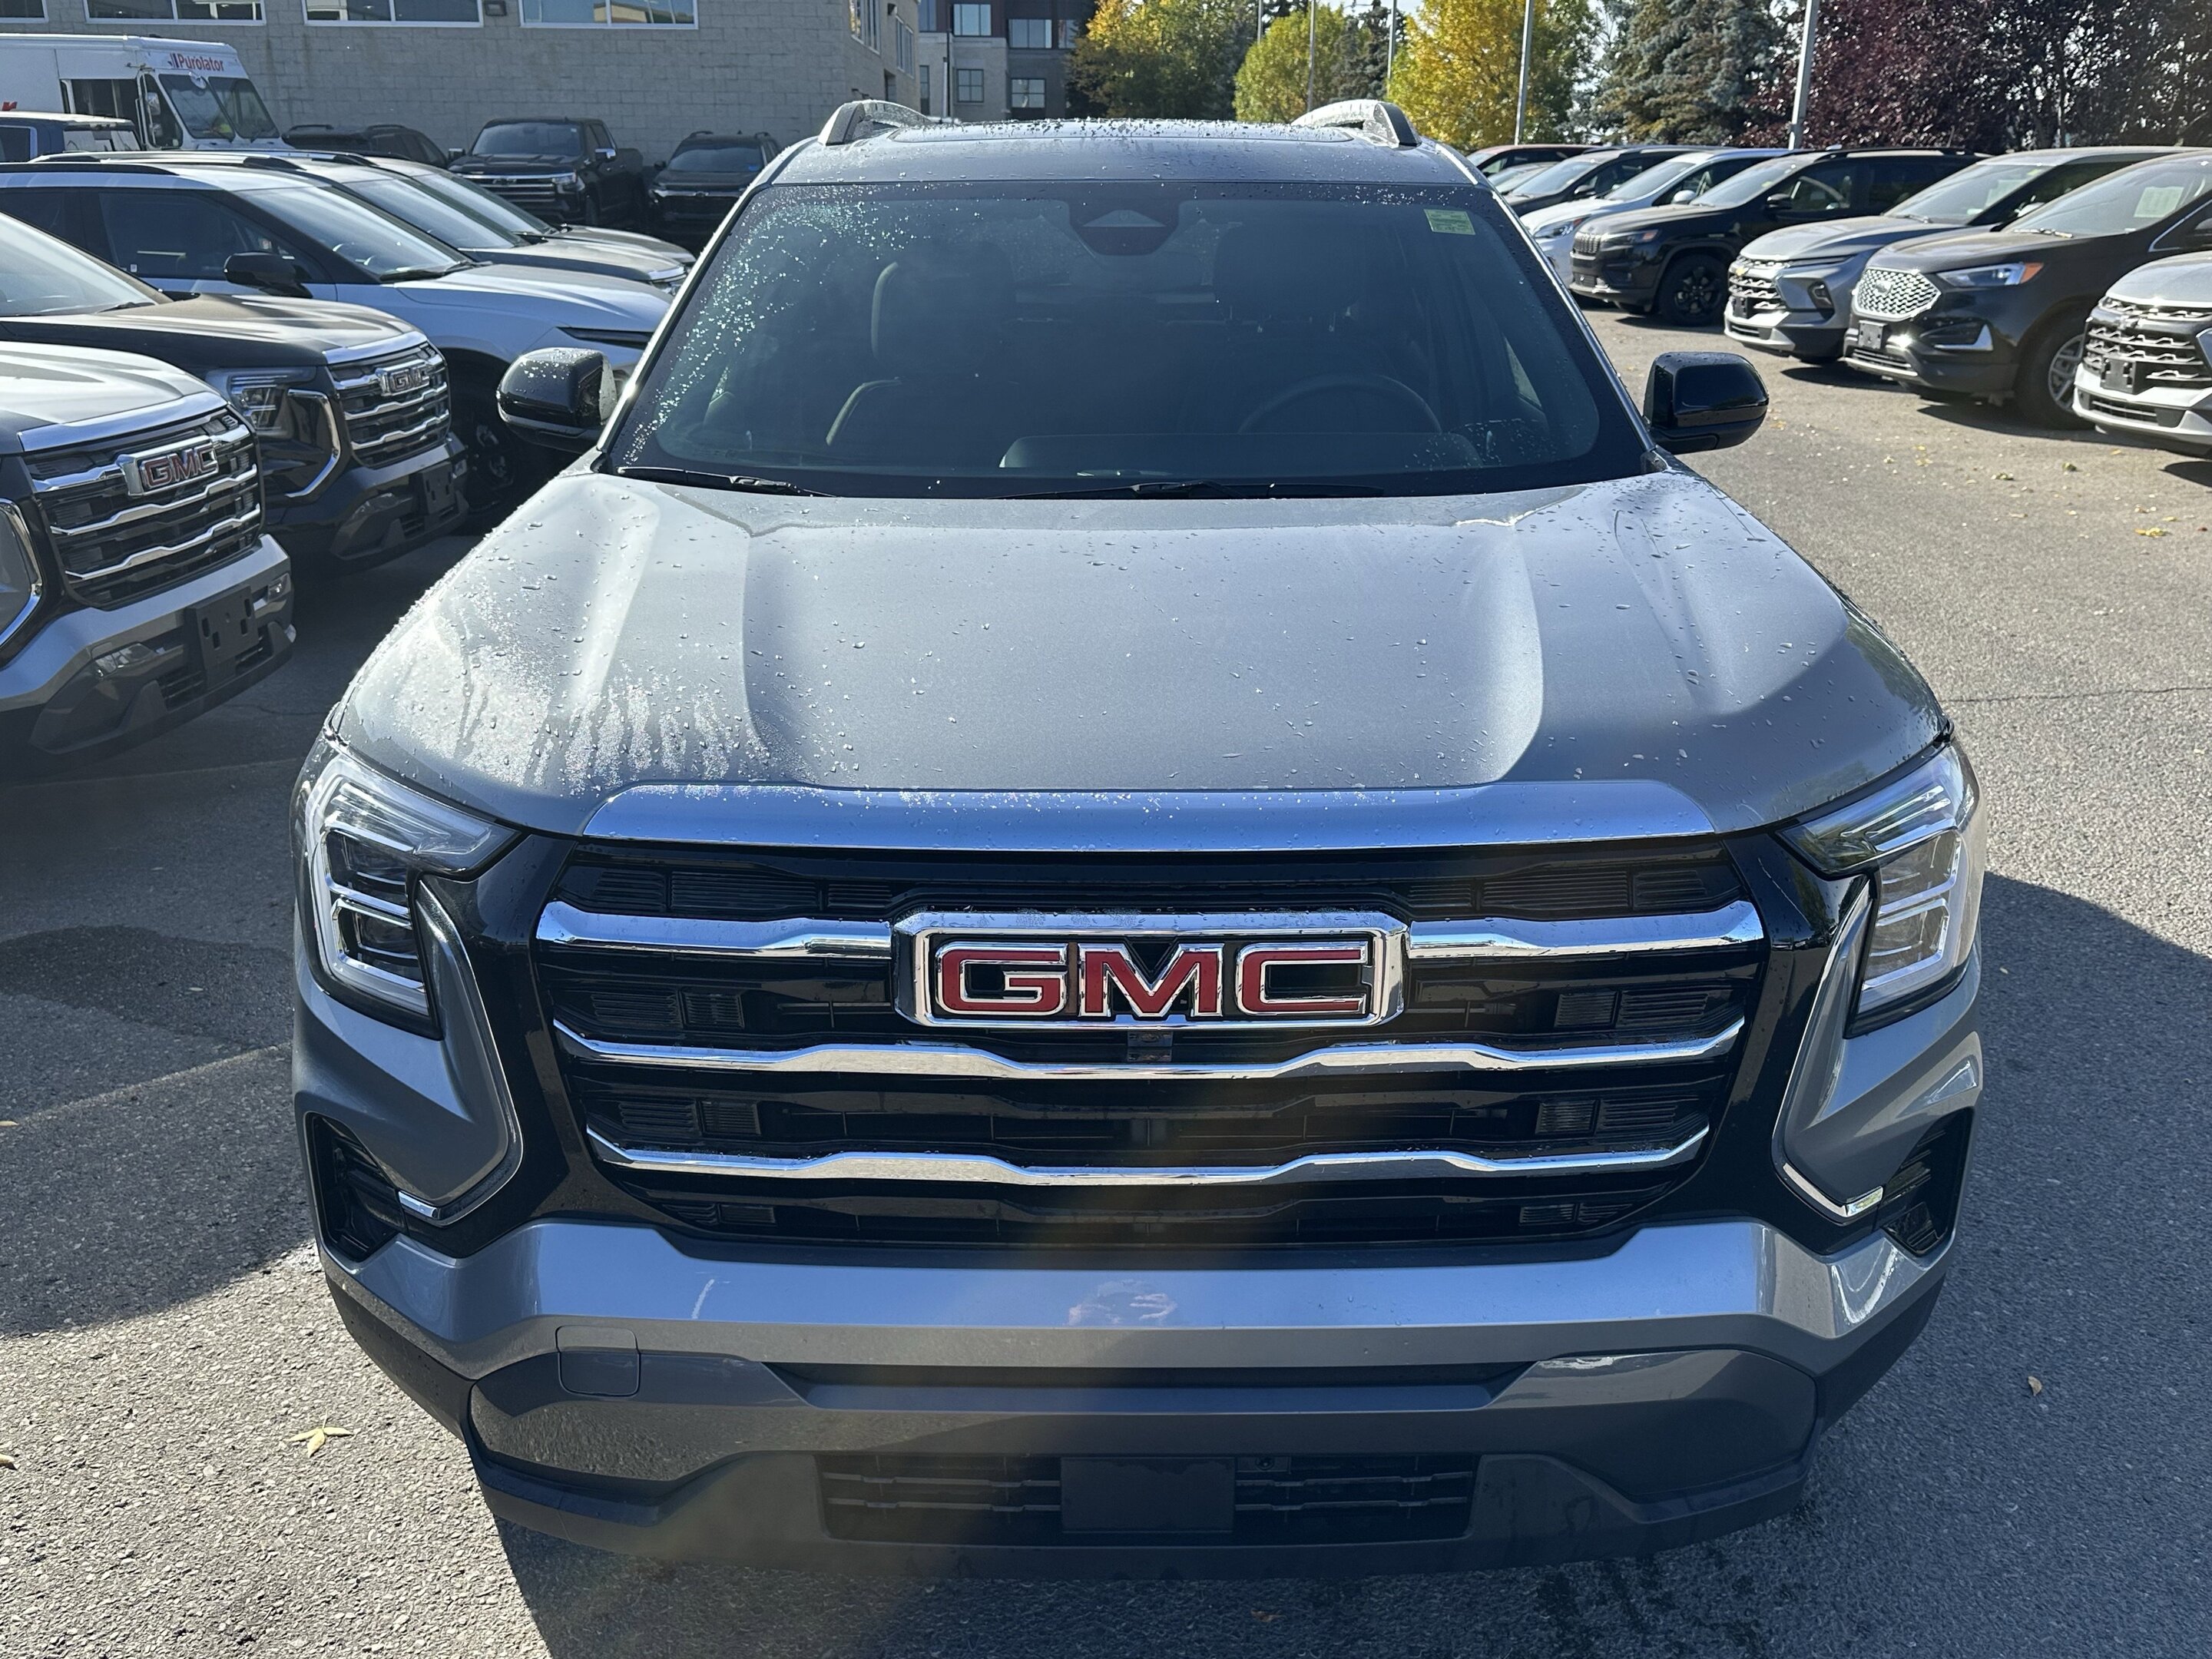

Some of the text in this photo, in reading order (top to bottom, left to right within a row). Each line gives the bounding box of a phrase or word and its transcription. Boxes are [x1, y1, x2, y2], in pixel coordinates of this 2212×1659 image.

[177, 53, 224, 71] Purolator
[391, 364, 429, 392] GMC
[139, 443, 218, 488] GMC
[934, 942, 1369, 1017] GMC
